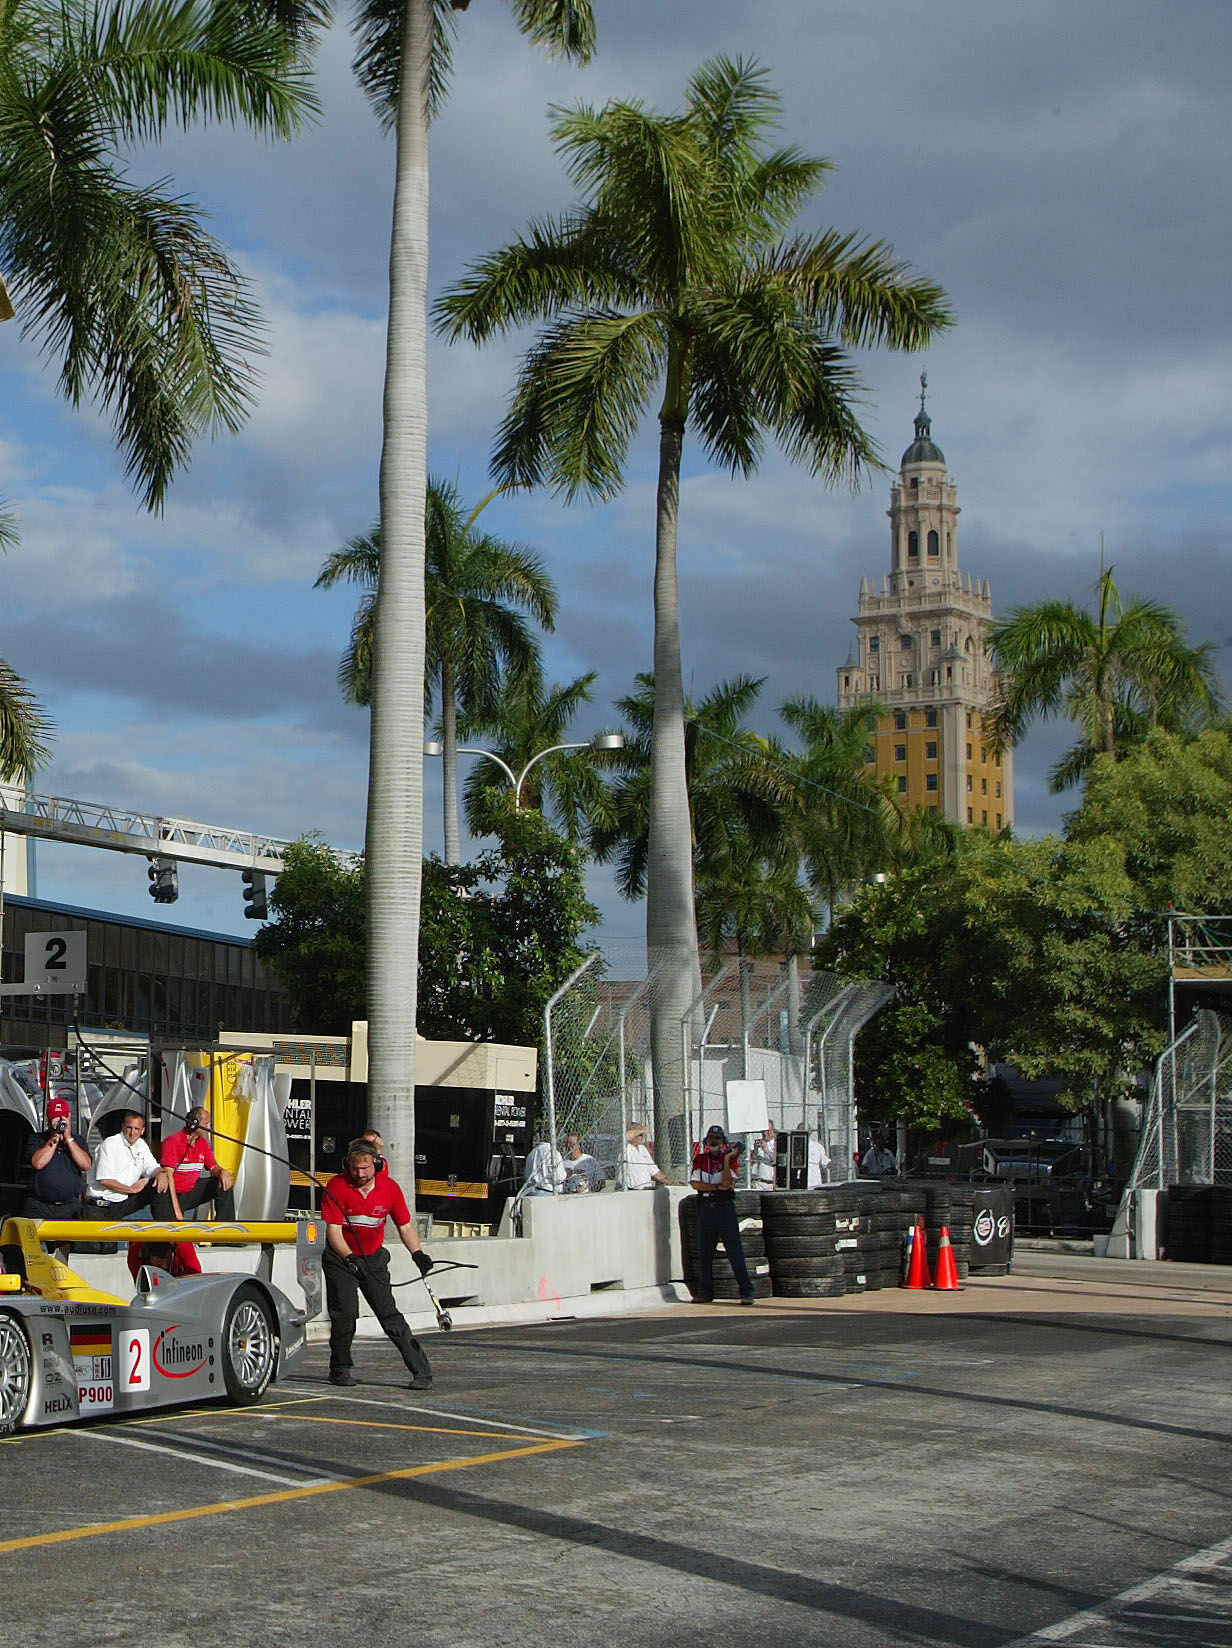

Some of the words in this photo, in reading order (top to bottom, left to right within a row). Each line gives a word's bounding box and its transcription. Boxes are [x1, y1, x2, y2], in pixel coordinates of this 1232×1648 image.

[45, 937, 67, 970] 2
[285, 1109, 311, 1120] NTAL
[287, 1098, 311, 1109] HLER
[161, 1331, 203, 1365] Infineon
[129, 1338, 141, 1384] 2
[45, 1397, 72, 1414] HELIX
